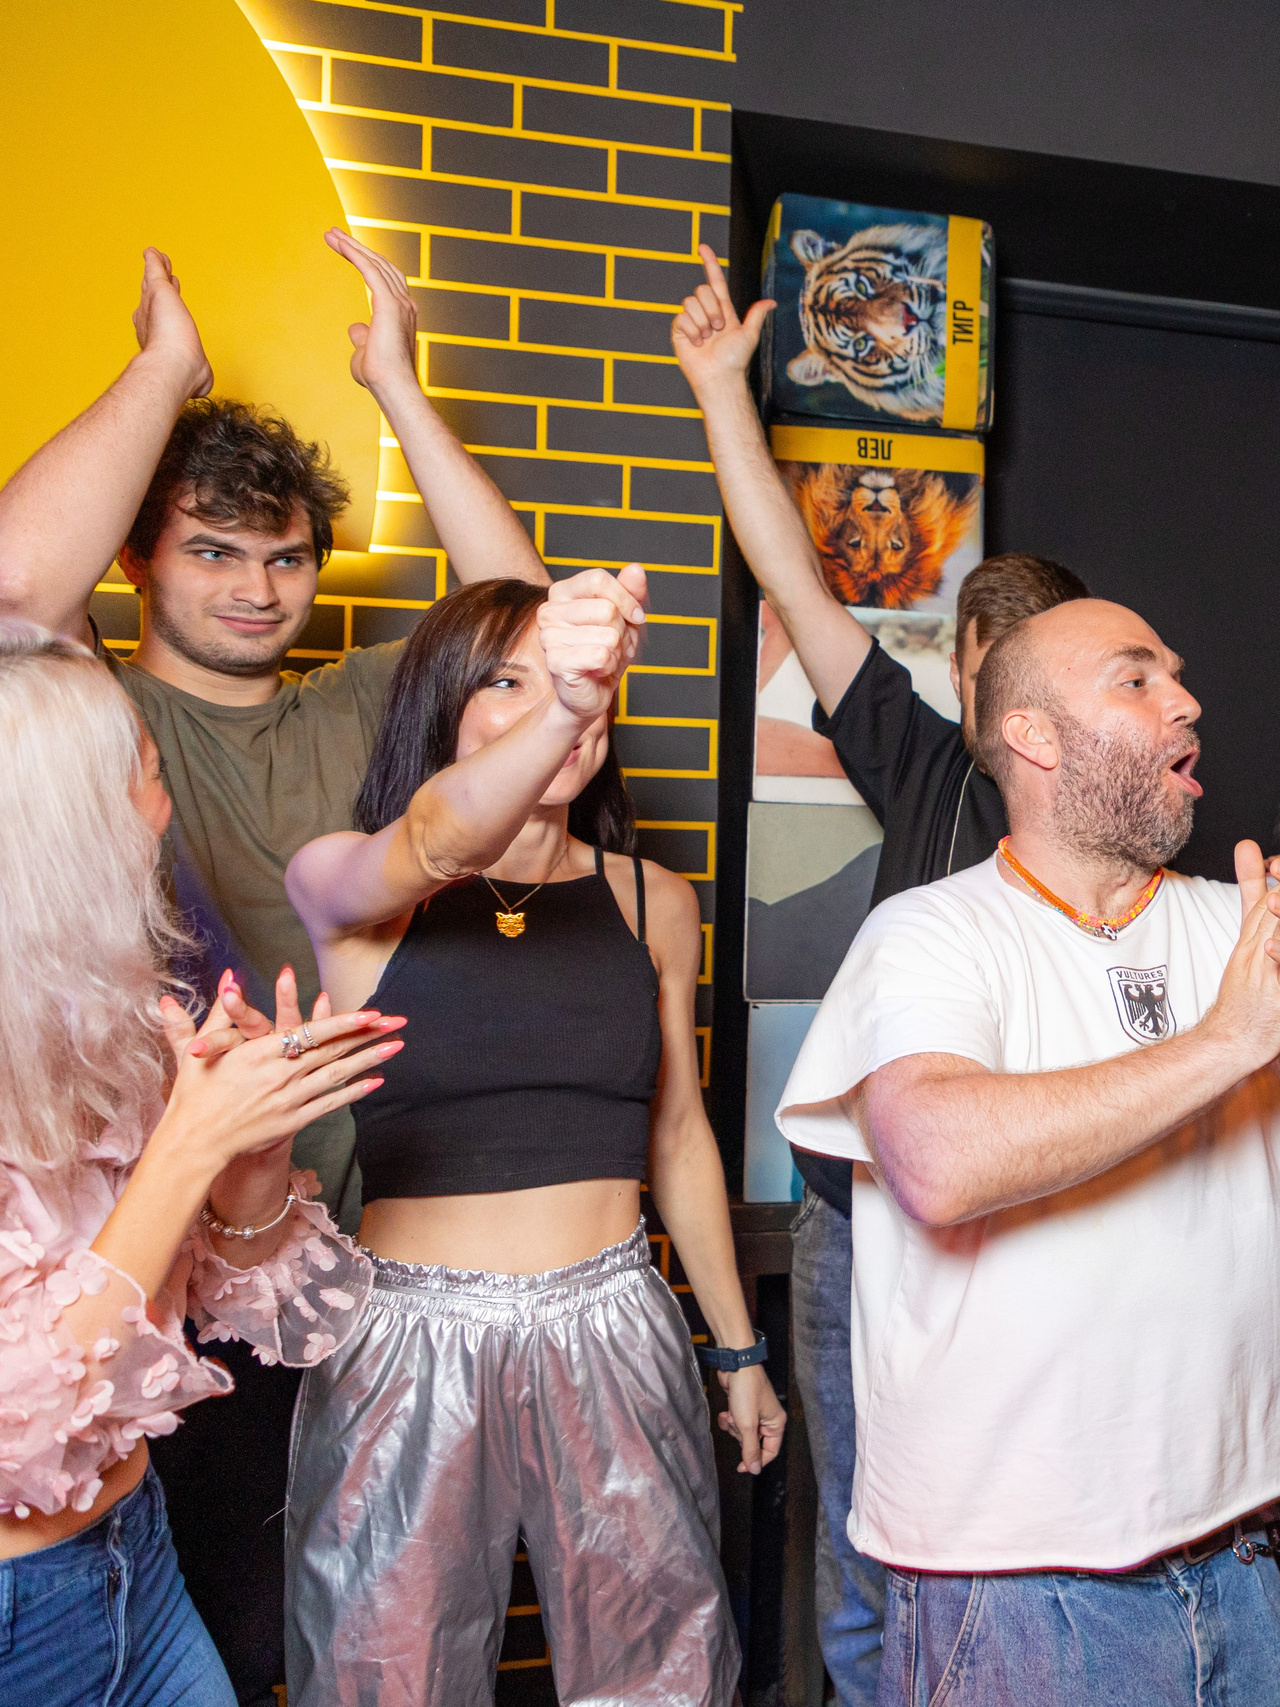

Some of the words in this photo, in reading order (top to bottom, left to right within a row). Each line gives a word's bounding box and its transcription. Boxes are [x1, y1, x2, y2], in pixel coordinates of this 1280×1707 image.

[952, 300, 974, 345] ТИГР
[857, 437, 893, 460] ЛЕВ
[1116, 970, 1164, 980] VULTURES
